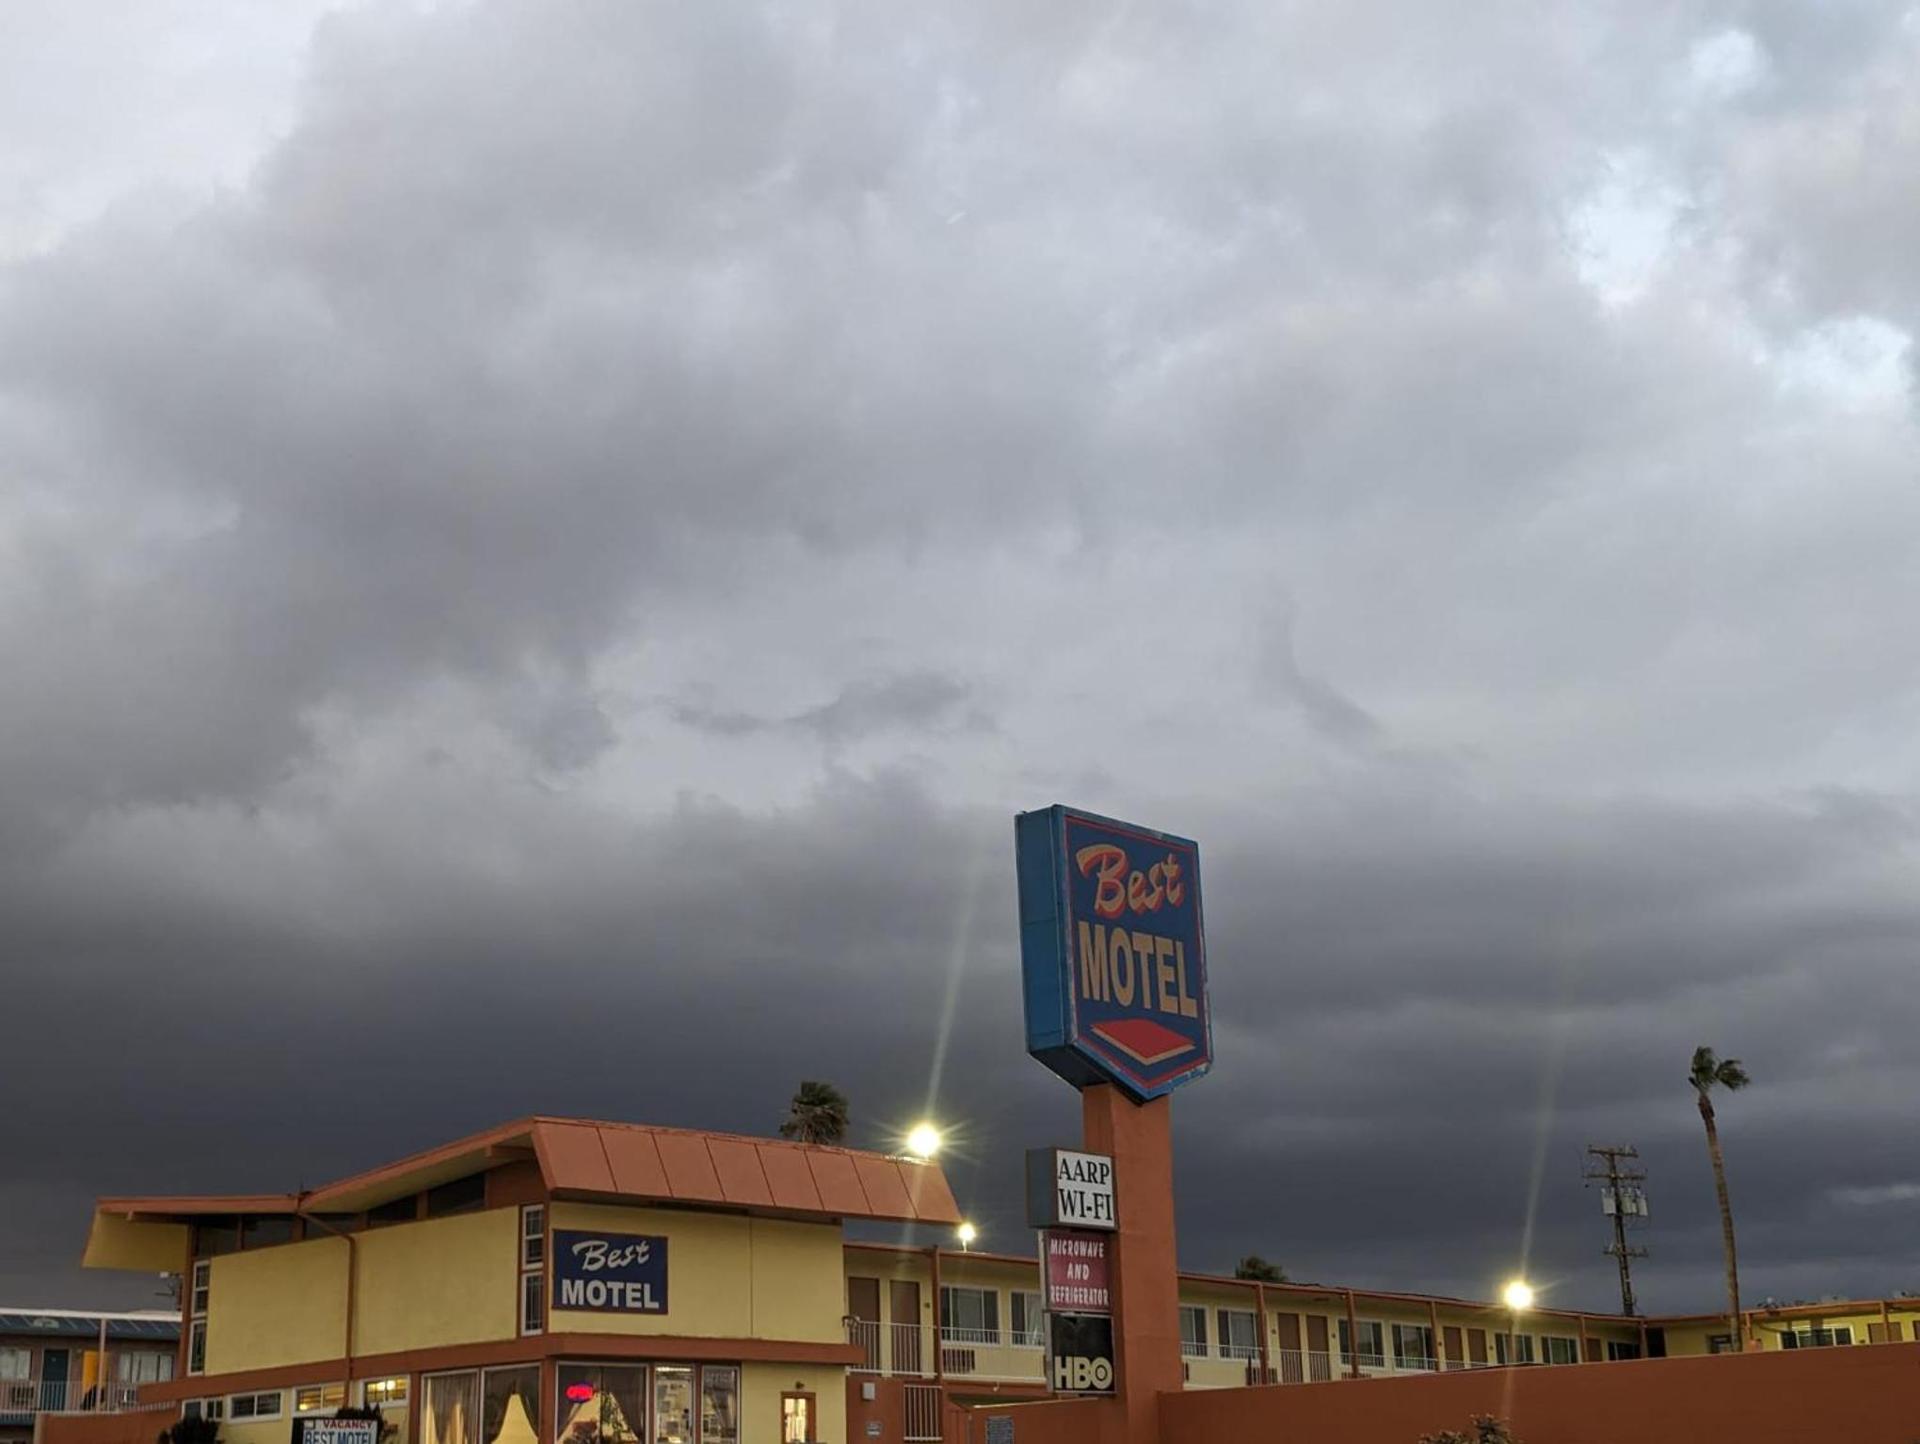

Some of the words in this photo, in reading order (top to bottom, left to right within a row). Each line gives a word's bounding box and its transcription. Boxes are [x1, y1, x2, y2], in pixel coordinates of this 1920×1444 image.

[1075, 843, 1186, 920] Best
[1078, 921, 1198, 1019] MOTEL
[1058, 1157, 1110, 1185] AARP
[1058, 1188, 1113, 1221] WI-FI
[571, 1240, 650, 1271] Best
[1050, 1238, 1105, 1258] MICROWAVE
[1067, 1262, 1090, 1280] AND
[561, 1278, 660, 1309] MOTEL
[1050, 1284, 1109, 1306] REFRIGERATOR
[1054, 1356, 1113, 1390] HBO
[304, 1430, 335, 1444] BEST
[323, 1419, 372, 1429] VACANCY
